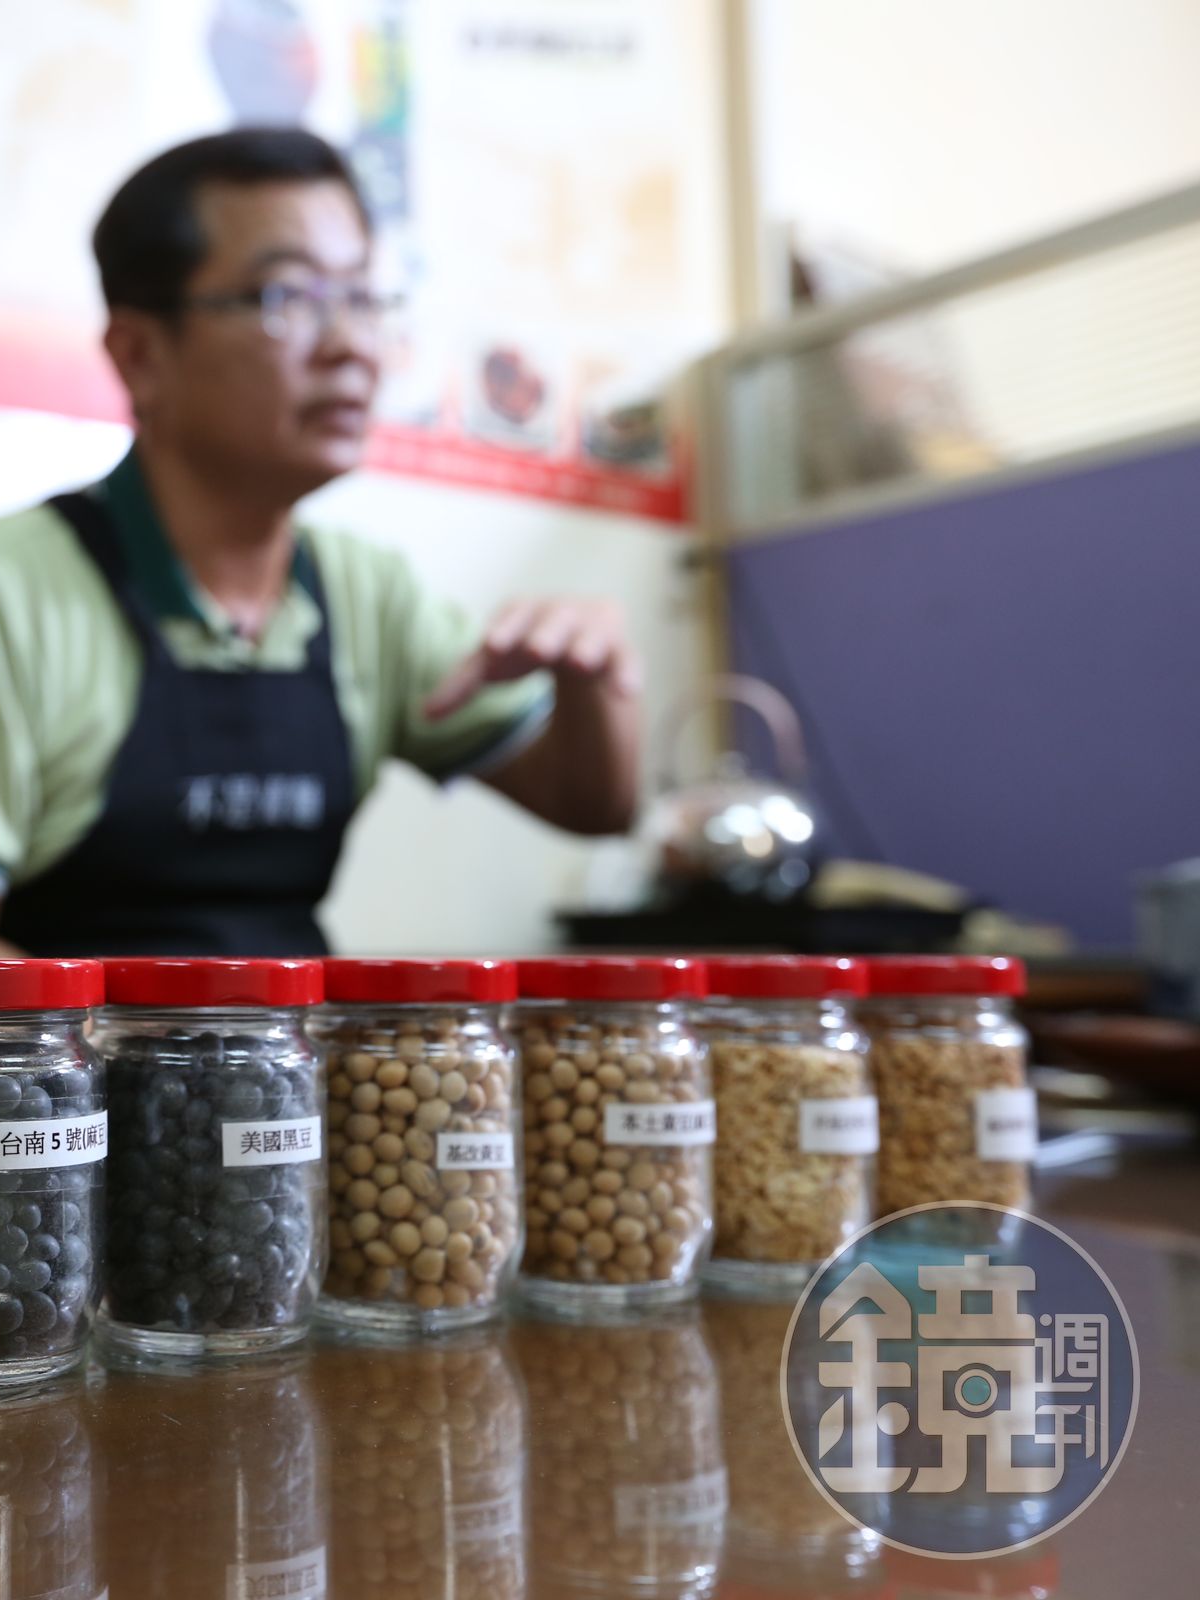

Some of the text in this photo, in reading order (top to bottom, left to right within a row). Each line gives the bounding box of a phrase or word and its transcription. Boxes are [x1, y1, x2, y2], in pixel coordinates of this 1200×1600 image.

[51, 1132, 61, 1151] 5
[240, 1127, 313, 1155] 美國黑豆
